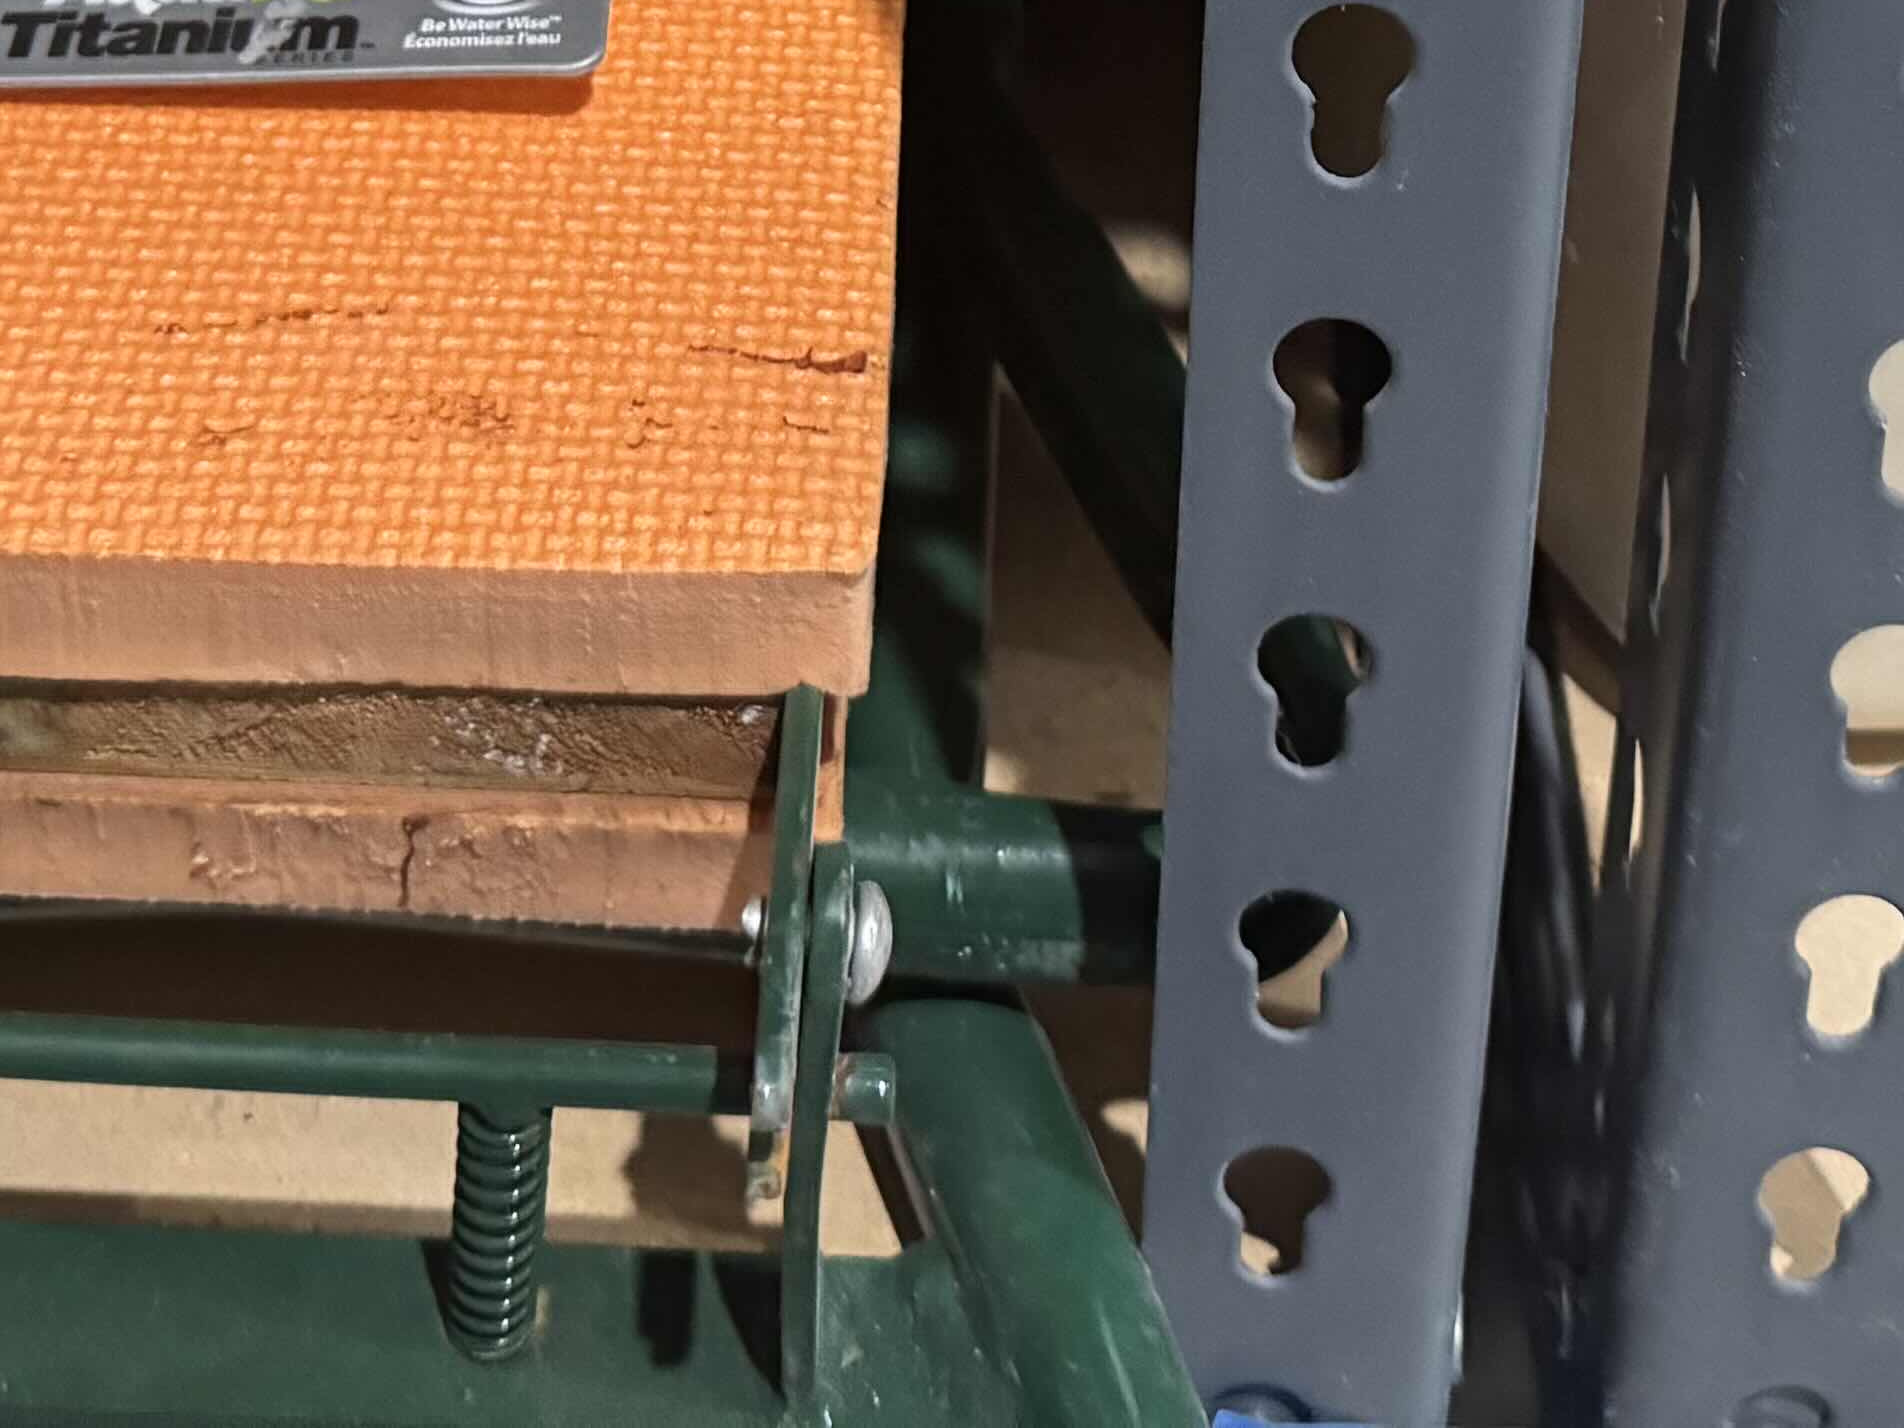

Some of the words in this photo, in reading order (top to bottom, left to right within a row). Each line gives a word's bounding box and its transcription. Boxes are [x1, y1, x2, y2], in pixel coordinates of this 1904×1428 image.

[420, 18, 447, 33] Be
[448, 16, 503, 32] Water
[403, 31, 515, 49] Économisez
